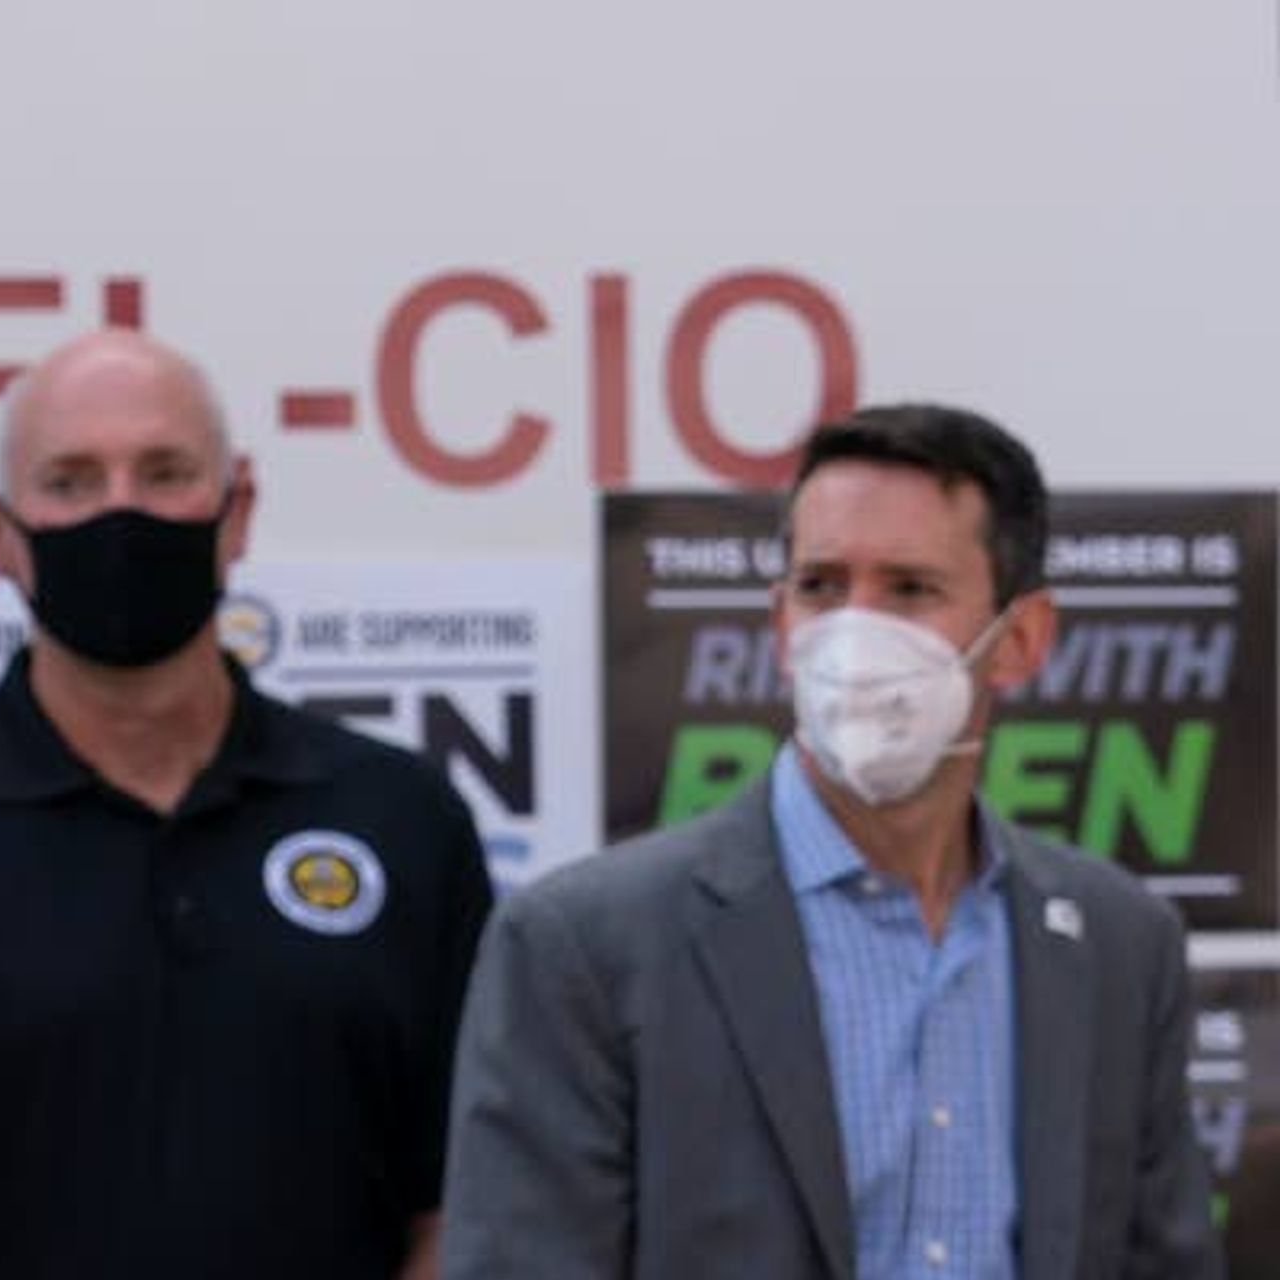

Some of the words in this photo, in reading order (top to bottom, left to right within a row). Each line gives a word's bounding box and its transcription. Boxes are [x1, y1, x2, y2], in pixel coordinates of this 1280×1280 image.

[648, 537, 748, 577] THIS
[1192, 535, 1238, 573] IS
[655, 722, 1217, 864] BEN
